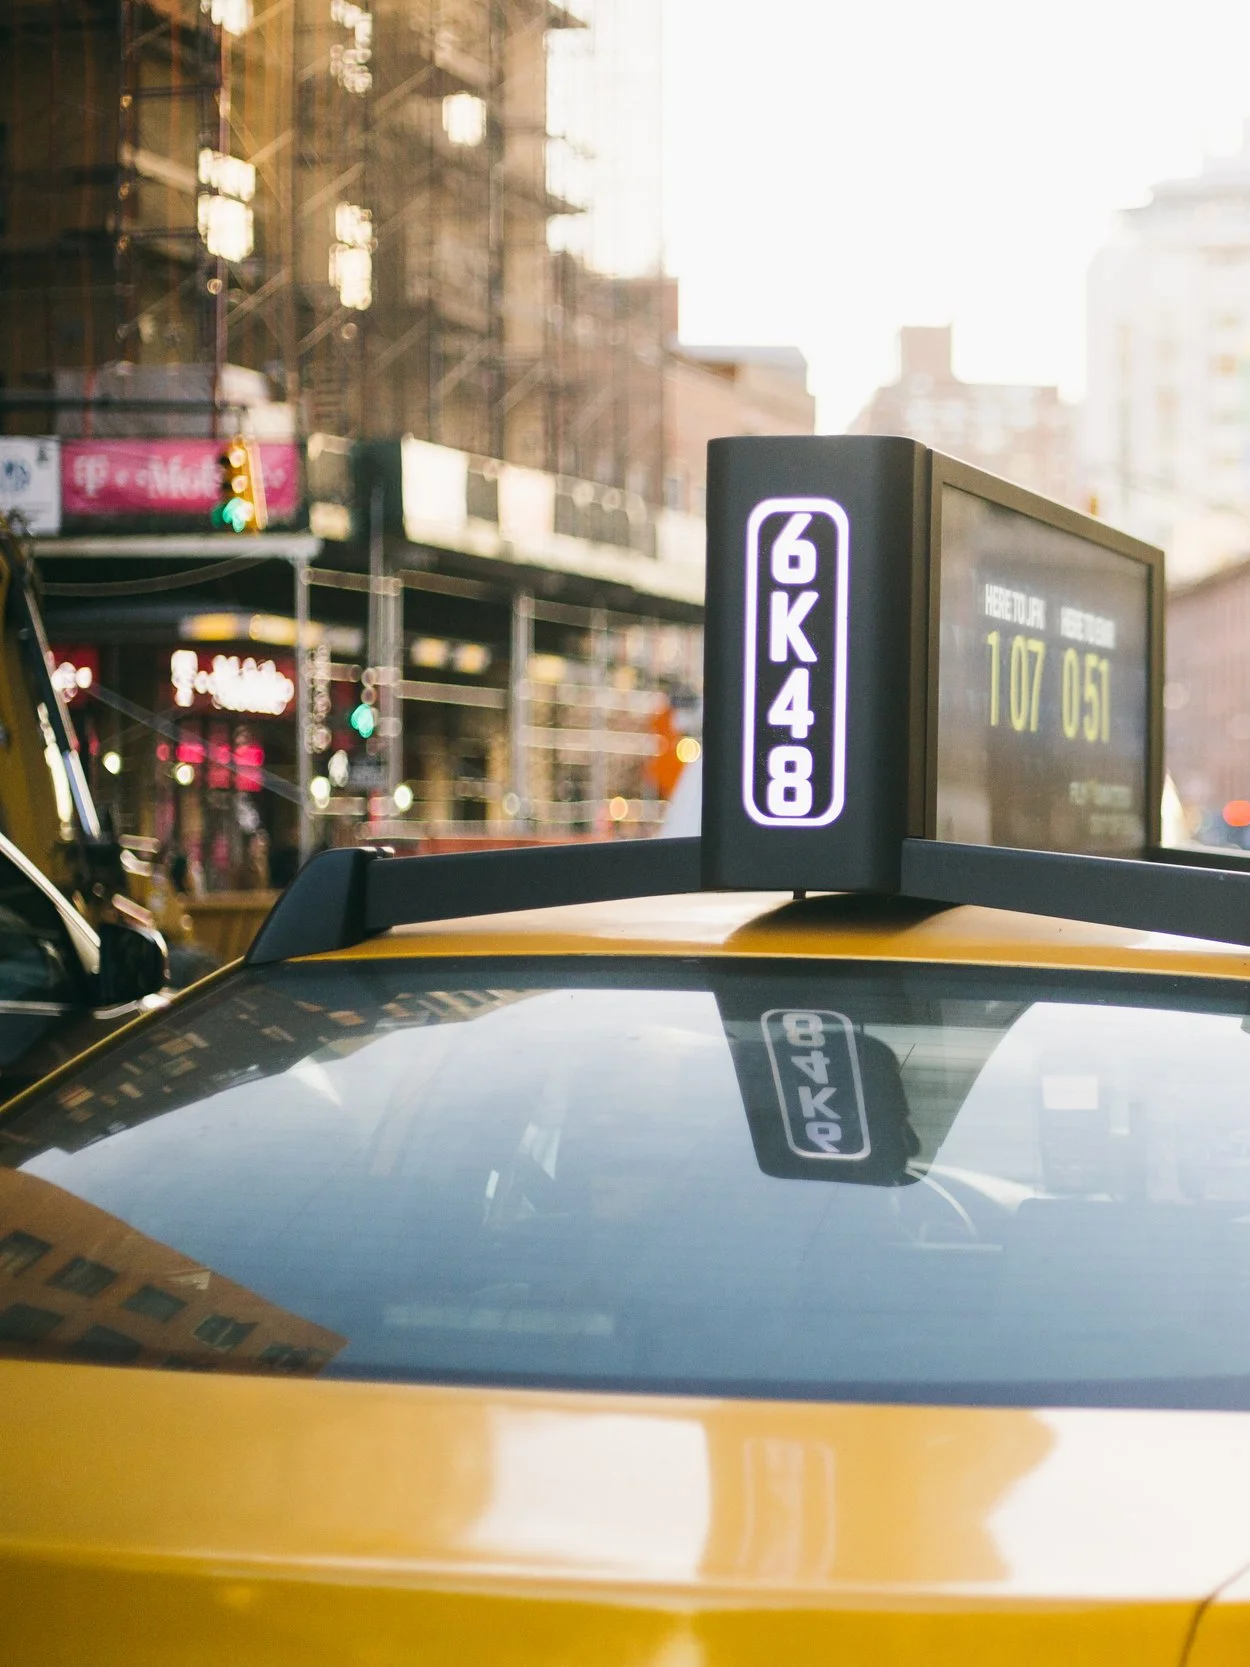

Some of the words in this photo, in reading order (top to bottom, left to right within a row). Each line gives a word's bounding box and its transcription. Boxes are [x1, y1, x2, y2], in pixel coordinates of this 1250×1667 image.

[767, 513, 819, 817] 6K48
[985, 583, 1011, 623] HERE
[1012, 589, 1025, 625] TO
